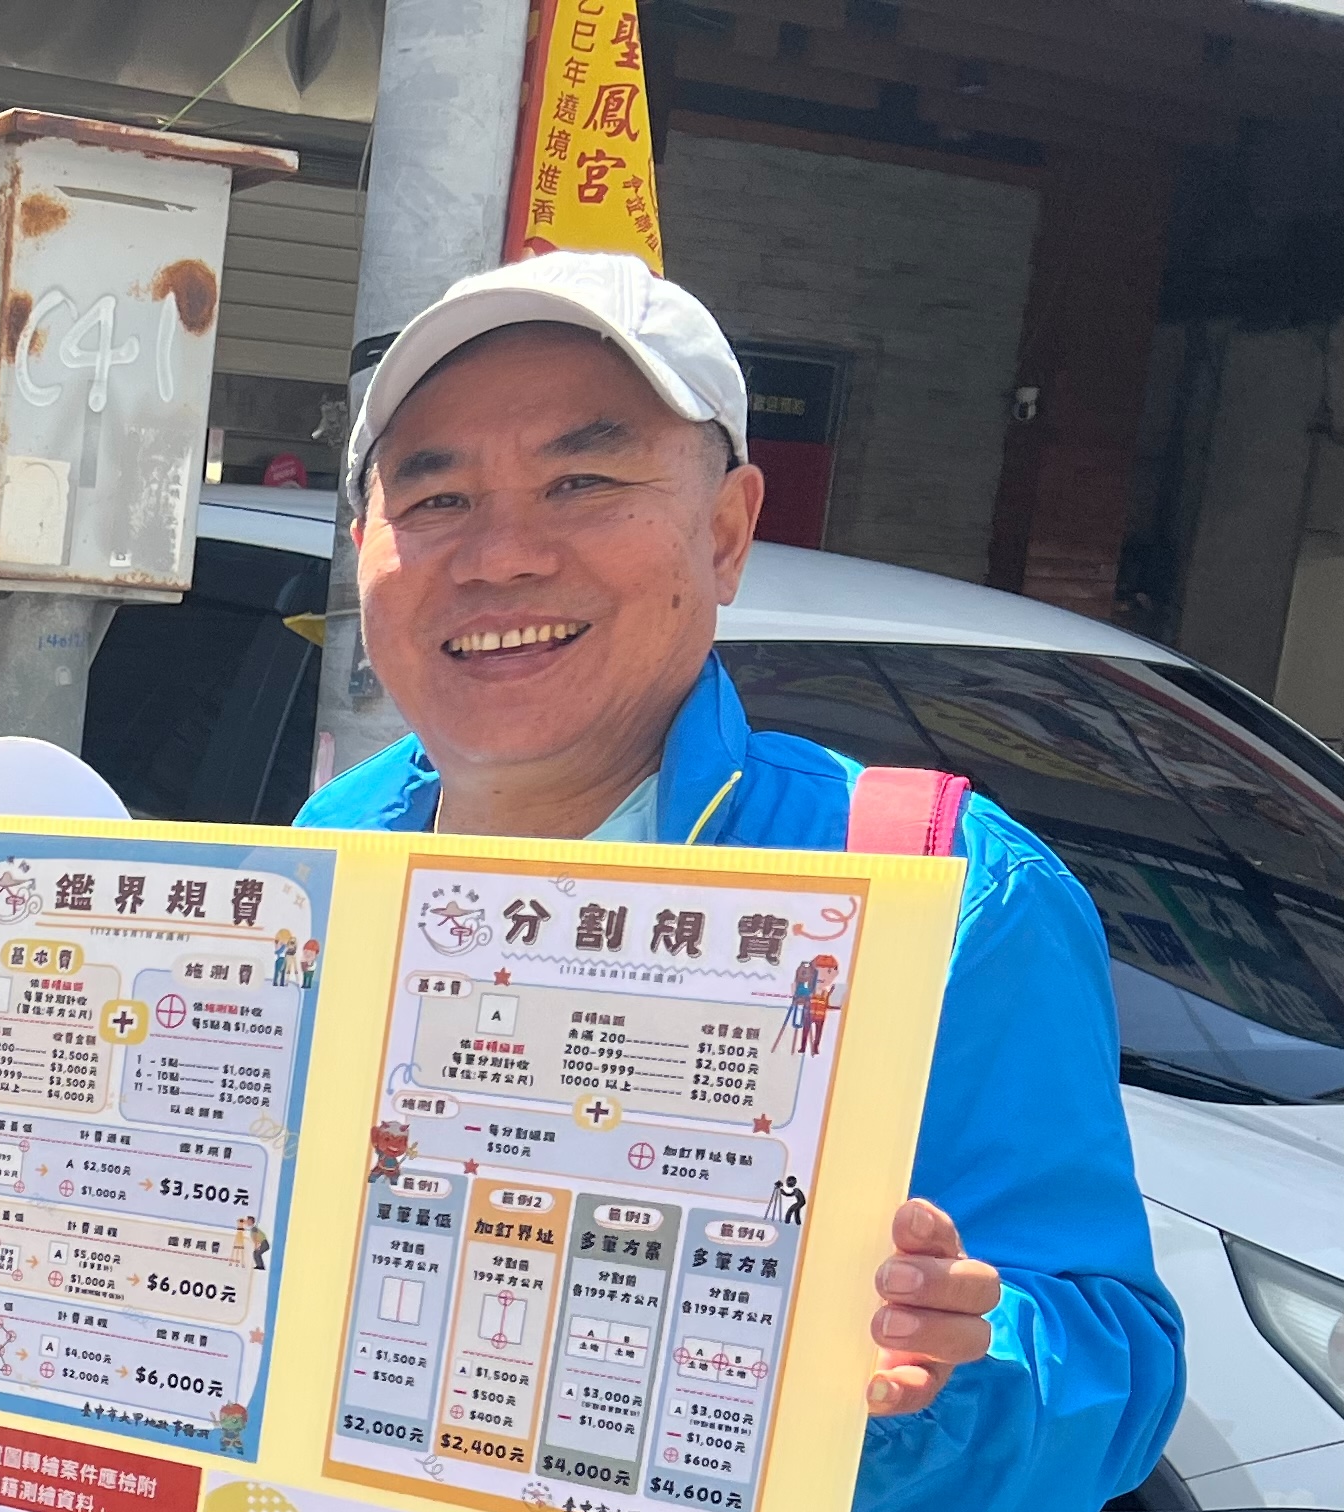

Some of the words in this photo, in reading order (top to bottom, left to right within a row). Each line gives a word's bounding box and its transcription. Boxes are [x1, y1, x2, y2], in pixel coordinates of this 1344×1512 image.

[52, 867, 265, 928] 鑑界規費
[498, 895, 793, 967] 分割規費
[10, 945, 73, 969] 基本費
[183, 959, 253, 985] 施測費
[416, 978, 462, 997] 基本費
[490, 1010, 503, 1022] A
[51, 1048, 99, 1064] $2,500元
[695, 1041, 760, 1060] $1,500元
[693, 1056, 761, 1076] $2,000元
[691, 1072, 757, 1092] $2,500元
[689, 1086, 756, 1107] $3,000元
[485, 1140, 533, 1158] $500元
[660, 1163, 711, 1181] $200元
[158, 1178, 251, 1208] $3,500元
[376, 1203, 453, 1230] 單筆最低
[473, 1217, 556, 1246] 加釘界址
[578, 1231, 662, 1261] 多筆方案
[690, 1247, 781, 1279] 多筆方案
[145, 1273, 238, 1305] $6,000元
[134, 1366, 225, 1400] $6,000元
[342, 1413, 426, 1445] $2,000元
[439, 1432, 526, 1465] $2,400元
[541, 1454, 632, 1488] $4,000元
[649, 1475, 745, 1510] $4,600元
